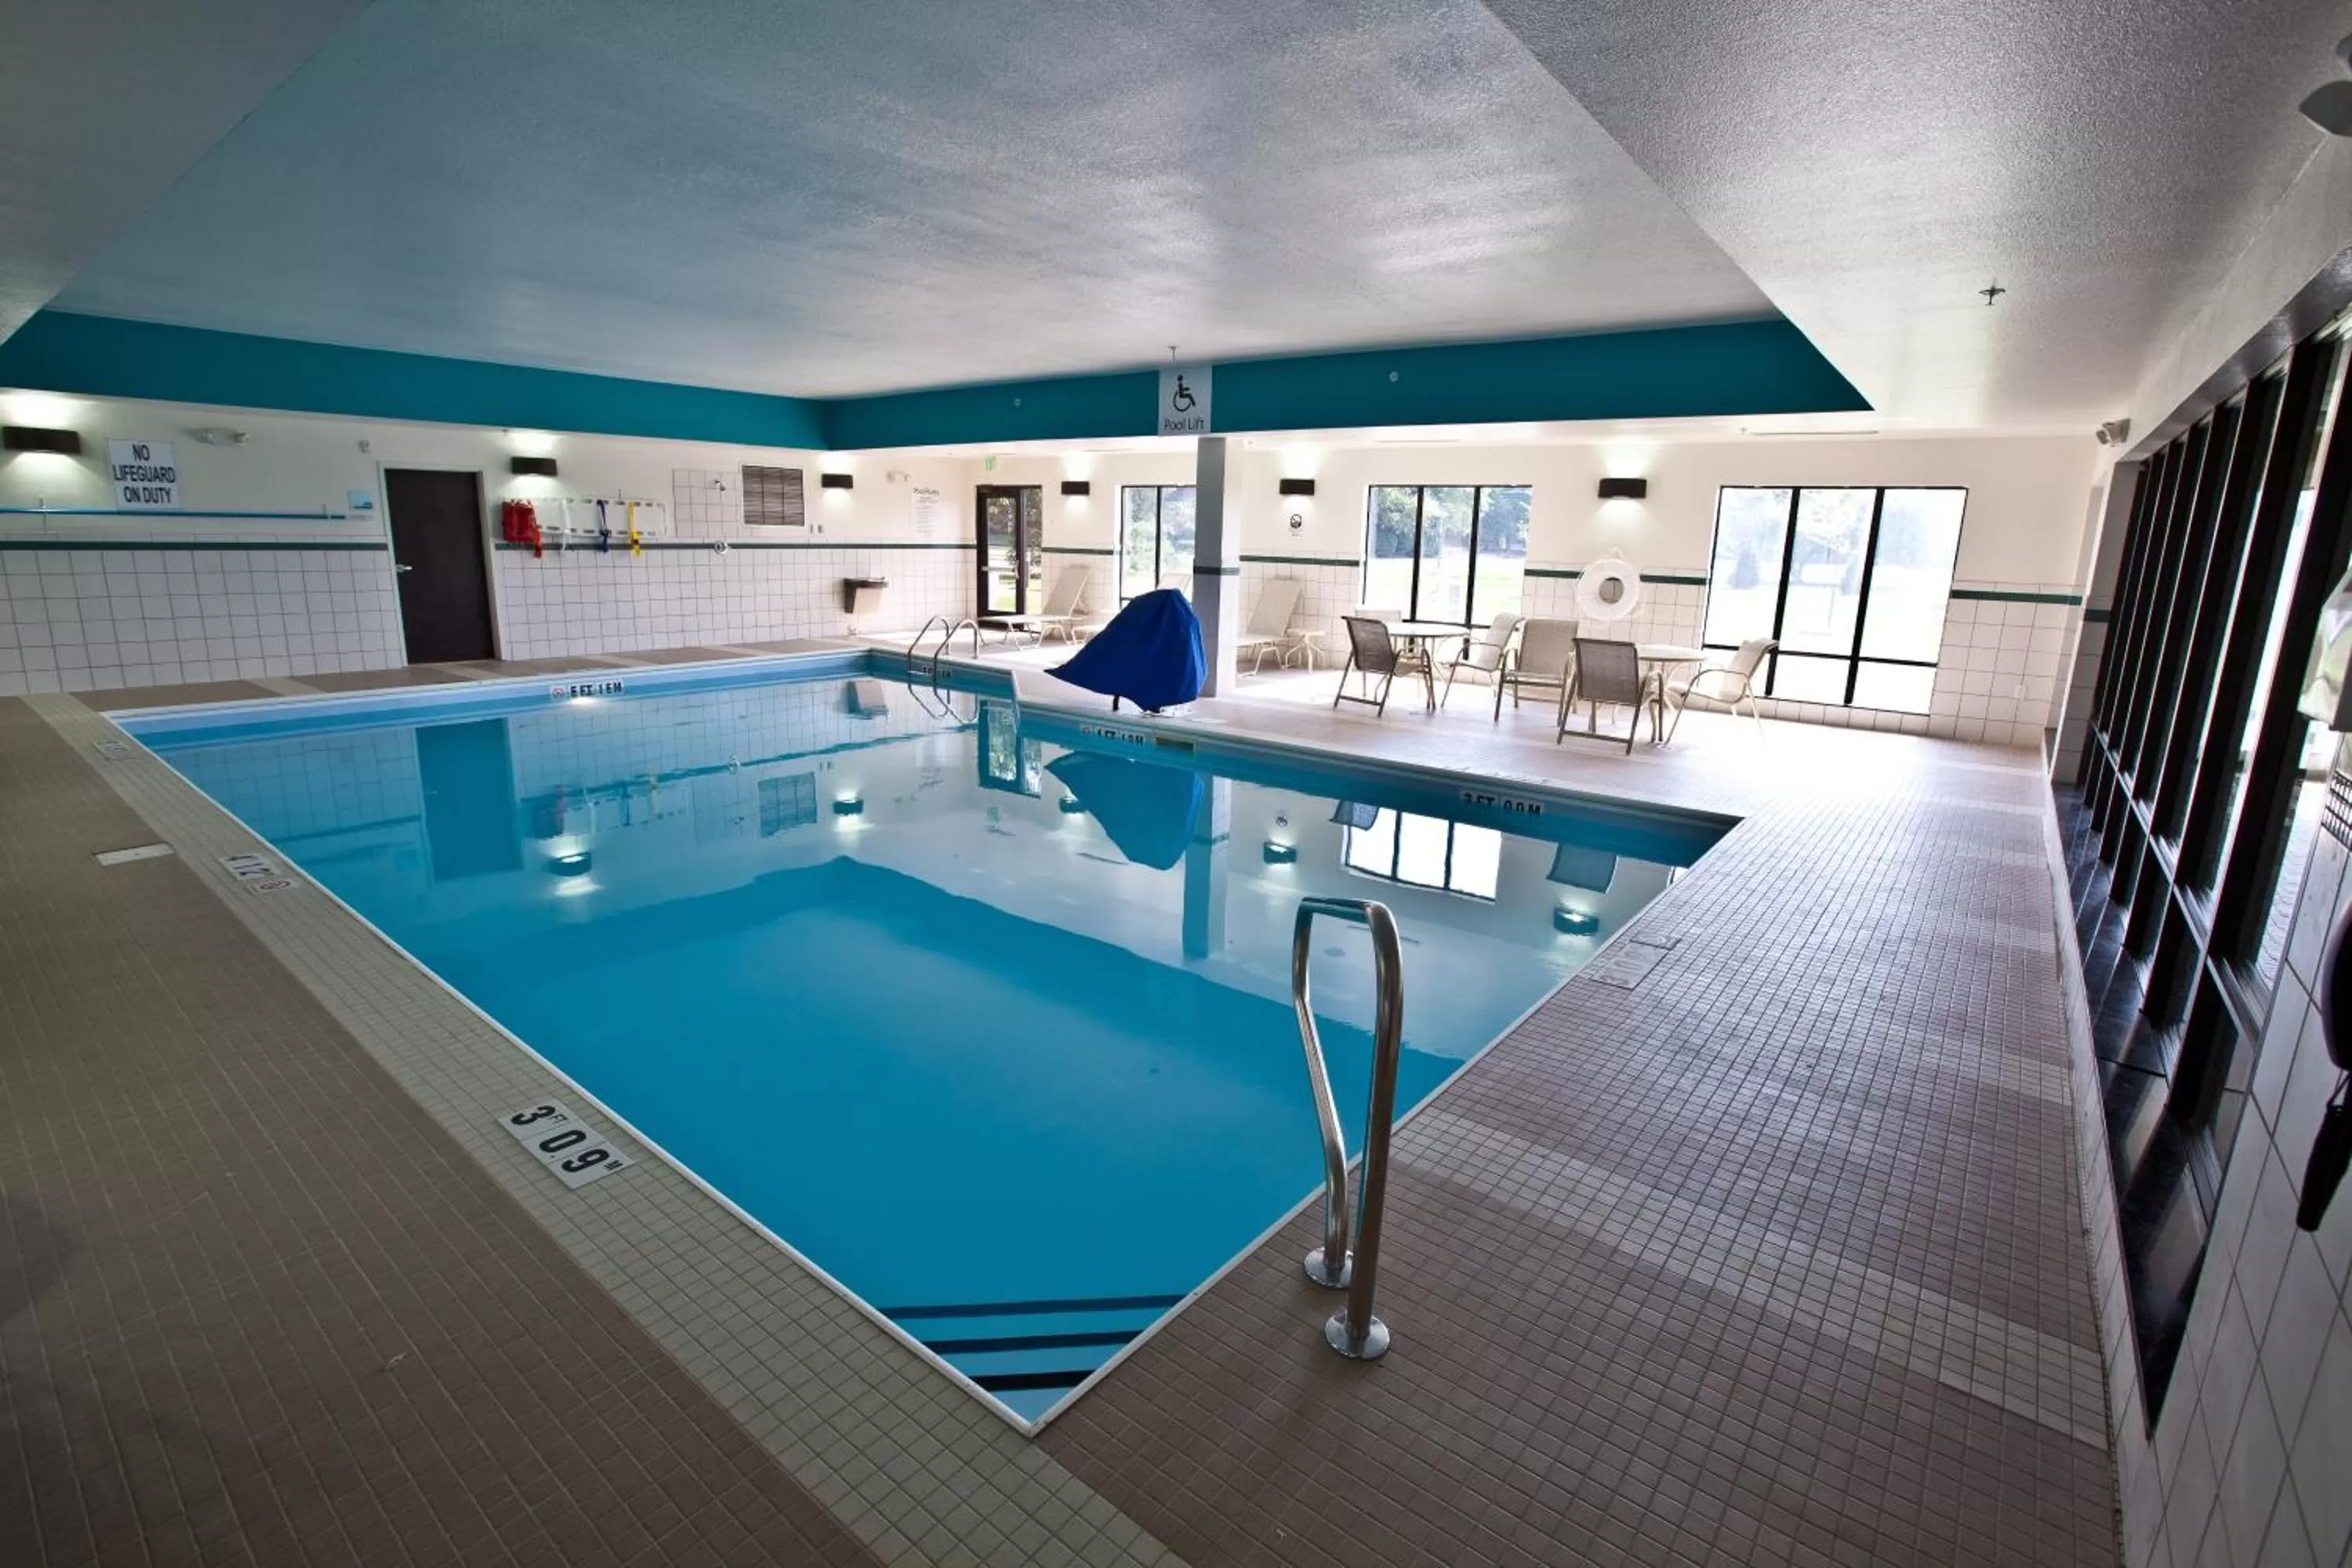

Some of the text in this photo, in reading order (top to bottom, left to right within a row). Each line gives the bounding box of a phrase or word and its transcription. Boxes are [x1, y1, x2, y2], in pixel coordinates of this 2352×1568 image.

[1163, 416, 1204, 430] Pool Lift
[132, 444, 150, 462] NO
[112, 464, 176, 483] LIFEGUARD
[124, 486, 171, 503] ON DUTY
